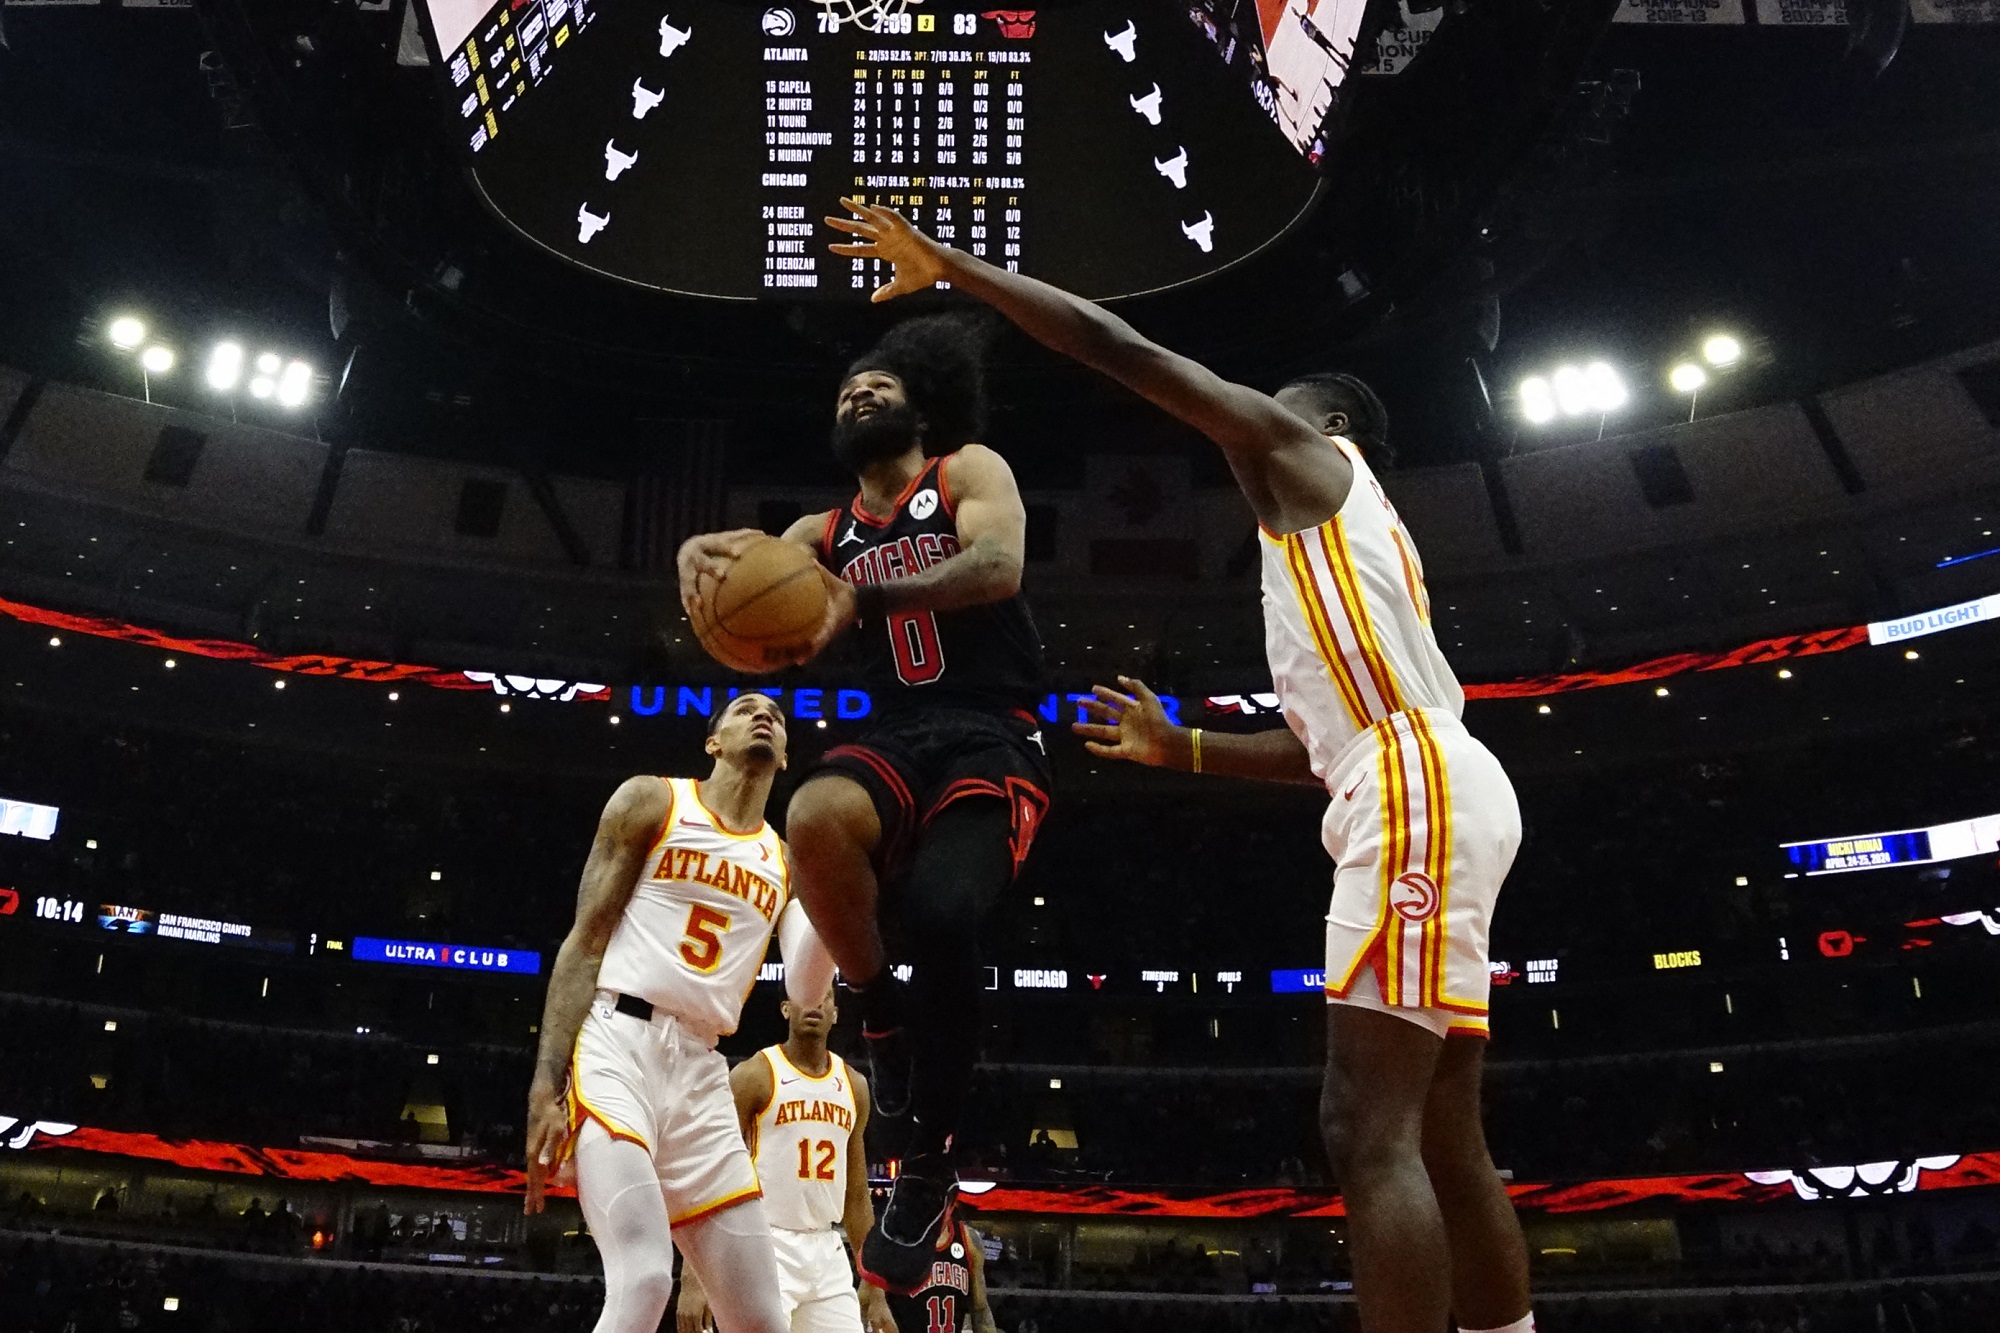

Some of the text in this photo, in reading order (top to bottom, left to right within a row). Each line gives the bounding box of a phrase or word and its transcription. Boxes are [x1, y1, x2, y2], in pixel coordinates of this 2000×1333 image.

[953, 13, 977, 35] 83
[763, 47, 809, 61] ATLANTA
[890, 50, 912, 62] 52.8%
[931, 50, 947, 63] 7/19
[1008, 51, 1031, 63] 83.3%
[854, 69, 1020, 80] MIN F PTS REB FG 3PT FT
[766, 81, 1023, 97] 15 CAPELA 21 0 16 10 8/9 0/0 0/0
[766, 98, 776, 111] 12
[778, 98, 813, 111] HUNTER
[854, 98, 866, 112] 24
[877, 99, 882, 112] 1
[895, 99, 902, 112] 0
[915, 99, 920, 112] 1
[973, 100, 989, 113] 0/3
[1007, 100, 1023, 114] 0/0
[767, 115, 1025, 131] 11 YOUNG 24 1 14 0 2/6 1/4 9/11
[765, 132, 1022, 148] 13 BOGDANOVIC 22 1 14 5 6/11 2/5 0/0
[769, 149, 776, 162] 5
[778, 149, 813, 162] MURRAY
[853, 150, 866, 163] 26
[875, 150, 882, 163] 2
[892, 150, 904, 163] 26
[913, 151, 920, 163] 3
[938, 151, 957, 164] 9/15
[973, 151, 988, 164] 3/5
[762, 173, 807, 187] CHICAGO
[867, 175, 888, 188] 34/57
[929, 176, 945, 189] 7/15
[852, 195, 1018, 206] MIN F PTS REB FG 3PT FT
[763, 206, 774, 219] 24
[777, 206, 805, 219] GREEN
[912, 208, 919, 221] 3
[936, 208, 952, 222] 2/4
[973, 209, 985, 222] 1/1
[1006, 209, 1021, 223] 0/0
[768, 223, 1021, 240] 9 VUCEVIC 7/12 0/3 1/2
[768, 240, 774, 253] 0
[777, 240, 805, 253] WHITE
[973, 243, 986, 256] 1/3
[765, 257, 774, 270] 11
[776, 257, 815, 270] DEROZAN
[852, 258, 865, 271] 26
[874, 259, 881, 272] 0
[1007, 260, 1019, 274] 1/1
[764, 274, 774, 287] 12
[776, 274, 818, 288] DOSUNMU
[852, 275, 864, 288] 26
[873, 276, 880, 289] 3
[840, 533, 964, 587] HICAGO
[1887, 604, 1981, 638] BUD LIGHT
[886, 609, 946, 687] 0
[630, 684, 873, 720] UNED
[1825, 857, 1848, 870] APRIL
[653, 848, 778, 924] ATLANTA
[36, 896, 84, 923] 10:14
[158, 913, 177, 926] SAN
[177, 916, 222, 932] FRANCISCO
[222, 922, 252, 937] GIANTS
[157, 925, 221, 944] MIAMI MARLINS
[310, 933, 317, 945] 3
[677, 901, 732, 976] 5
[385, 944, 509, 967] ULTRA CLUB
[1653, 950, 1702, 970] BLOCKS
[1526, 959, 1559, 972] HAWKS
[1014, 969, 1068, 989] CHICAGO
[1142, 970, 1179, 982] TIMEOUTS
[1217, 971, 1242, 983] FOULS
[1527, 971, 1556, 983] BULLS
[1157, 982, 1164, 993] 3
[1227, 982, 1233, 994] 1
[774, 1099, 857, 1132] ATLANTA
[797, 1137, 837, 1182] 12
[926, 1295, 956, 1333] 11
